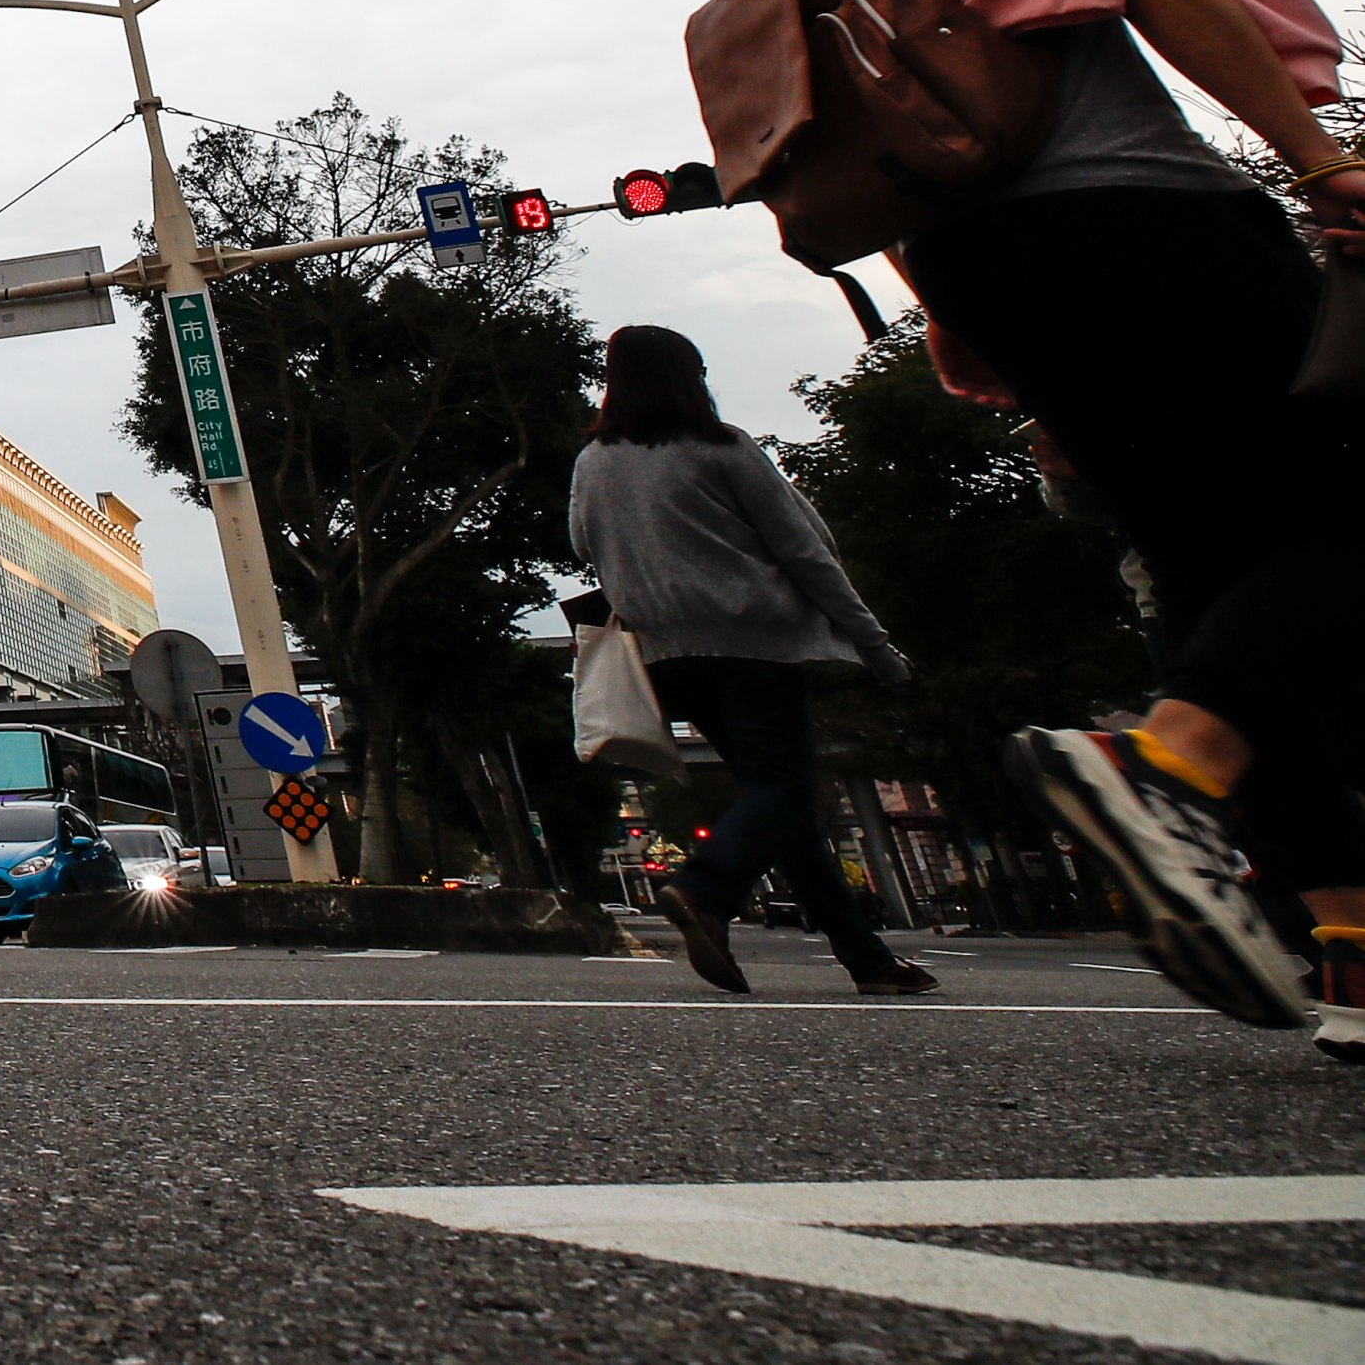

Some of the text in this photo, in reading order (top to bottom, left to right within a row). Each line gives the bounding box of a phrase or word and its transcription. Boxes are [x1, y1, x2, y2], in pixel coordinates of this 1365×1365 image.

[515, 197, 546, 227] 19
[179, 320, 220, 411] 市府路
[197, 421, 223, 432] City
[199, 431, 223, 442] Hall
